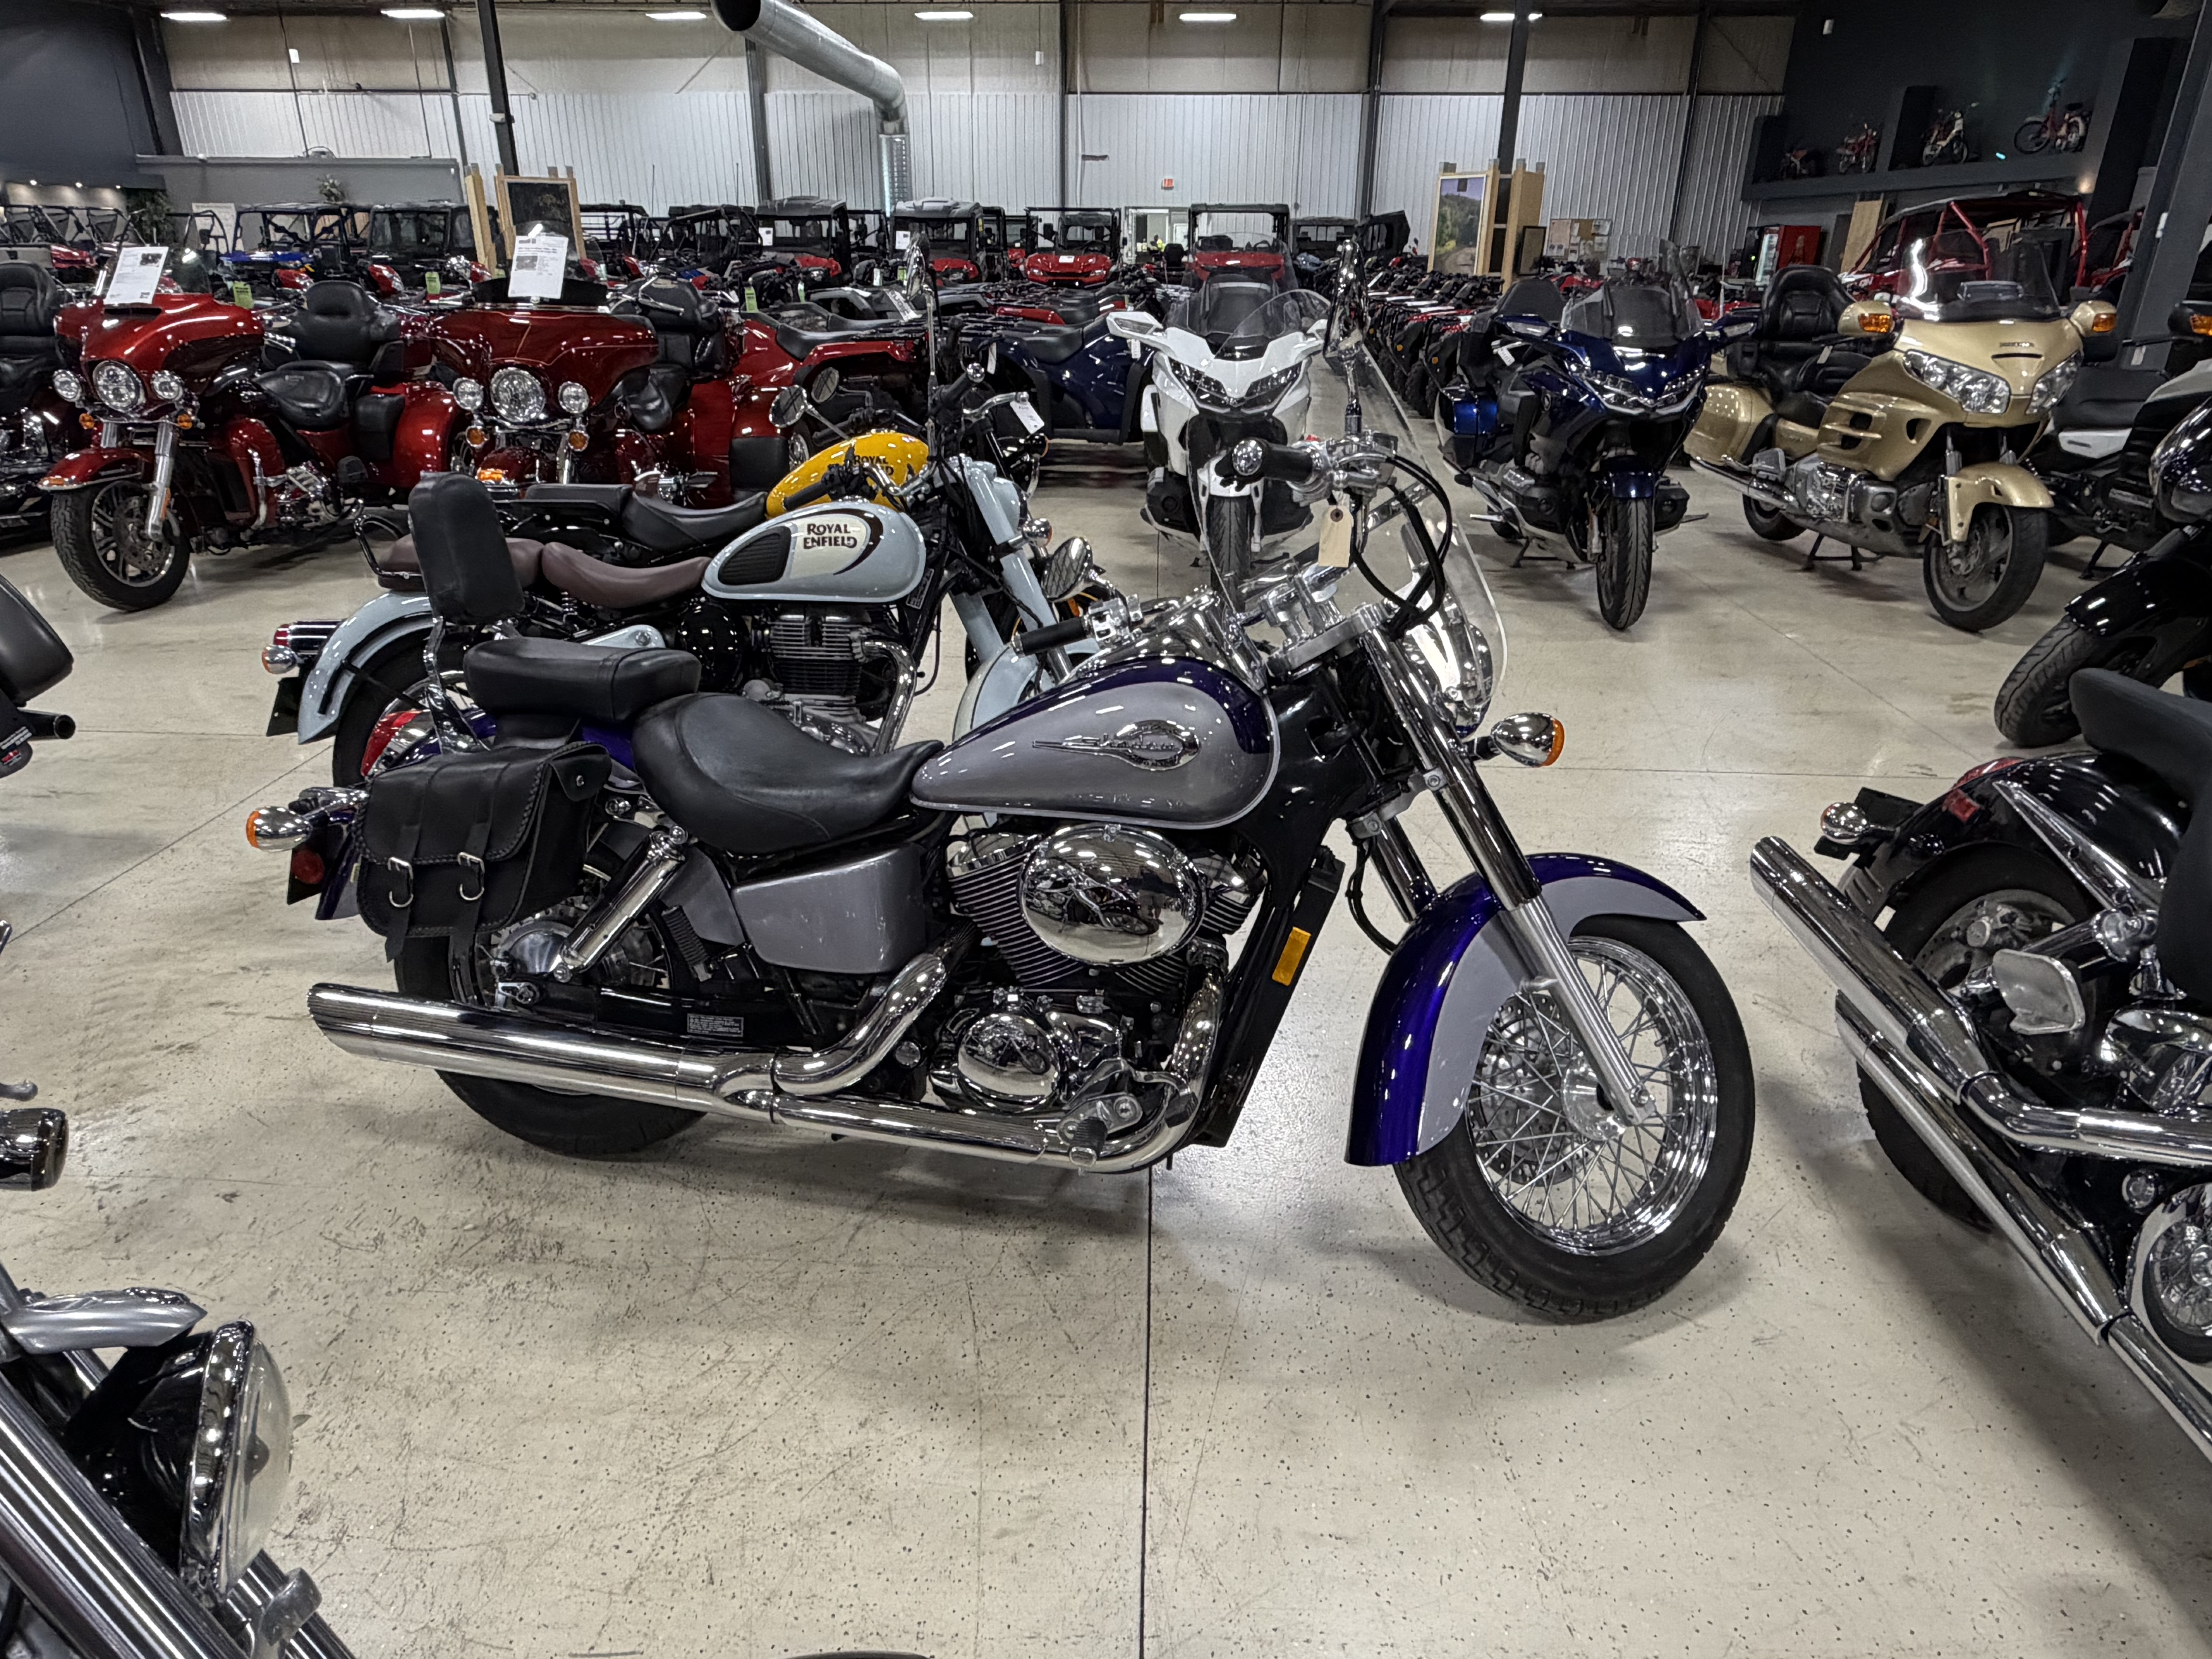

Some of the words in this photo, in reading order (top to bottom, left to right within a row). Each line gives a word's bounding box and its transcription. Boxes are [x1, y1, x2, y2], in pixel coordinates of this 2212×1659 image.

[854, 455, 888, 465] ROYAL
[807, 524, 851, 535] ROYAL
[803, 536, 857, 549] ENFIELD
